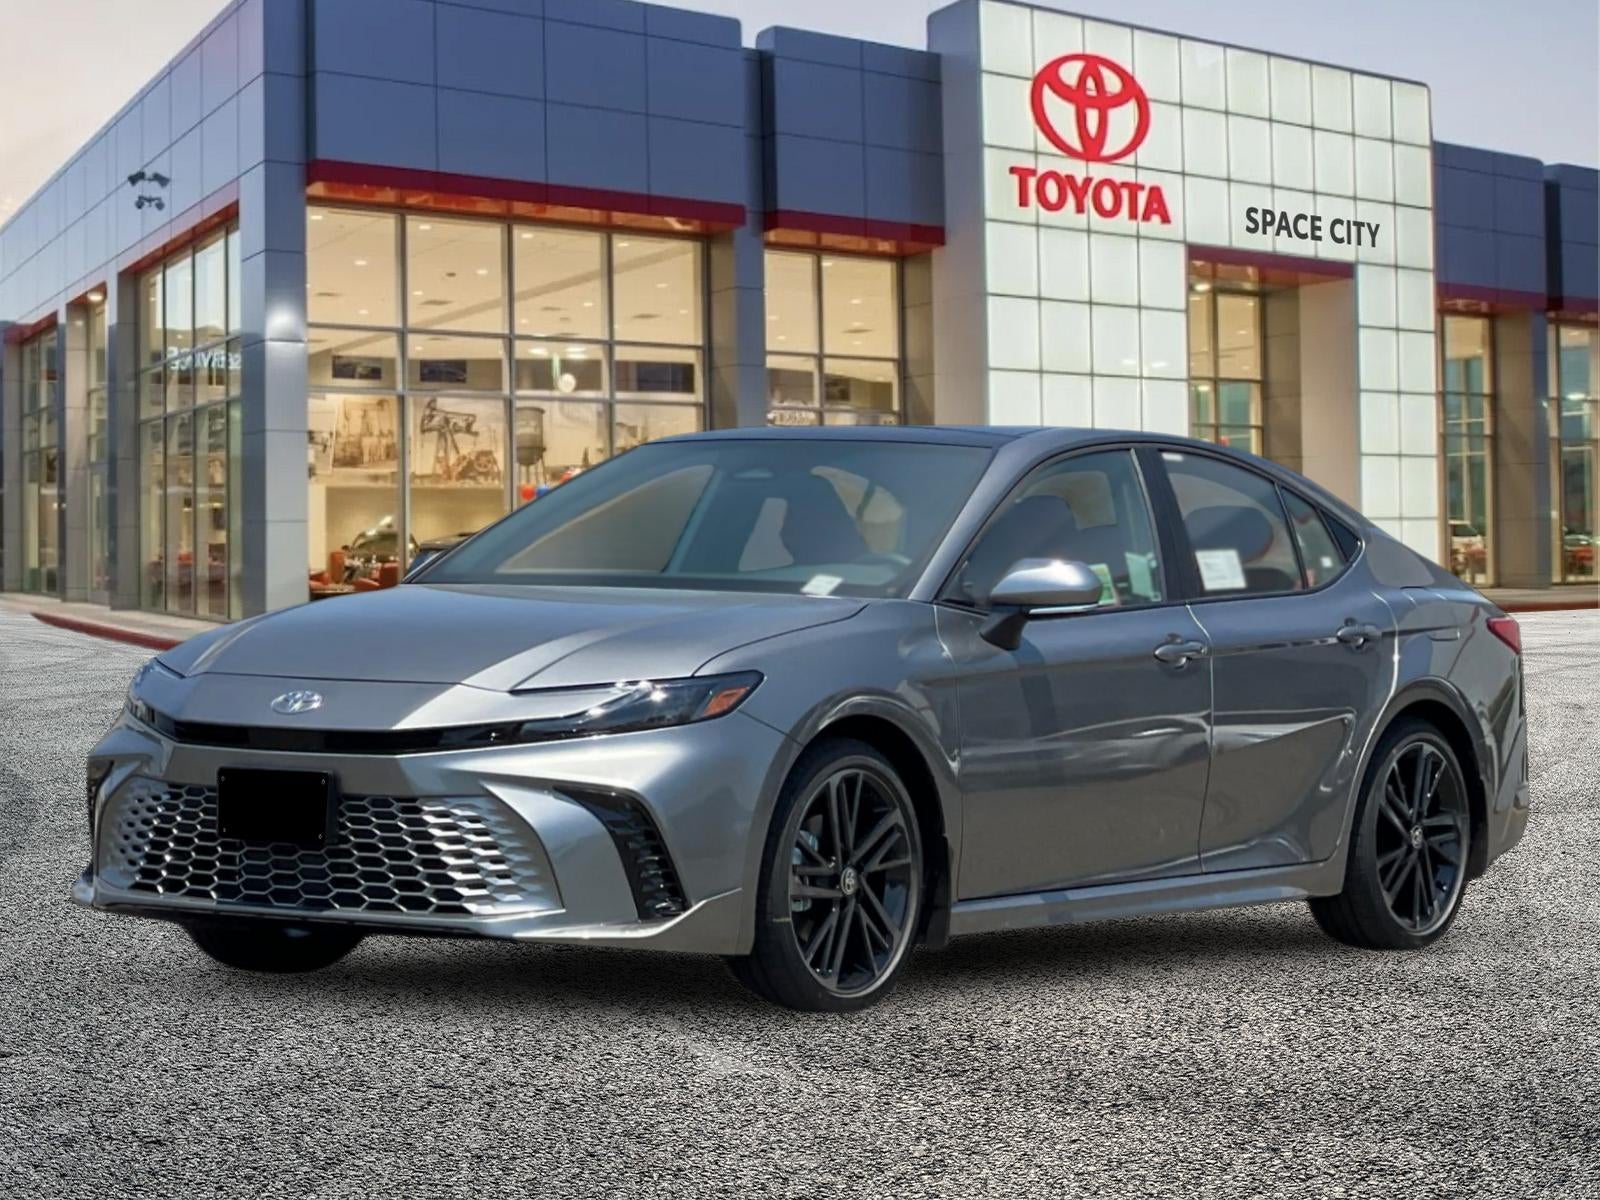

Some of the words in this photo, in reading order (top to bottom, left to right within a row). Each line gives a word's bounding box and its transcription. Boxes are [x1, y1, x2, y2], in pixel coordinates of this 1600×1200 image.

[1009, 166, 1171, 224] TOYOTA
[1245, 207, 1322, 241] SPACE
[1329, 218, 1380, 248] CITY
